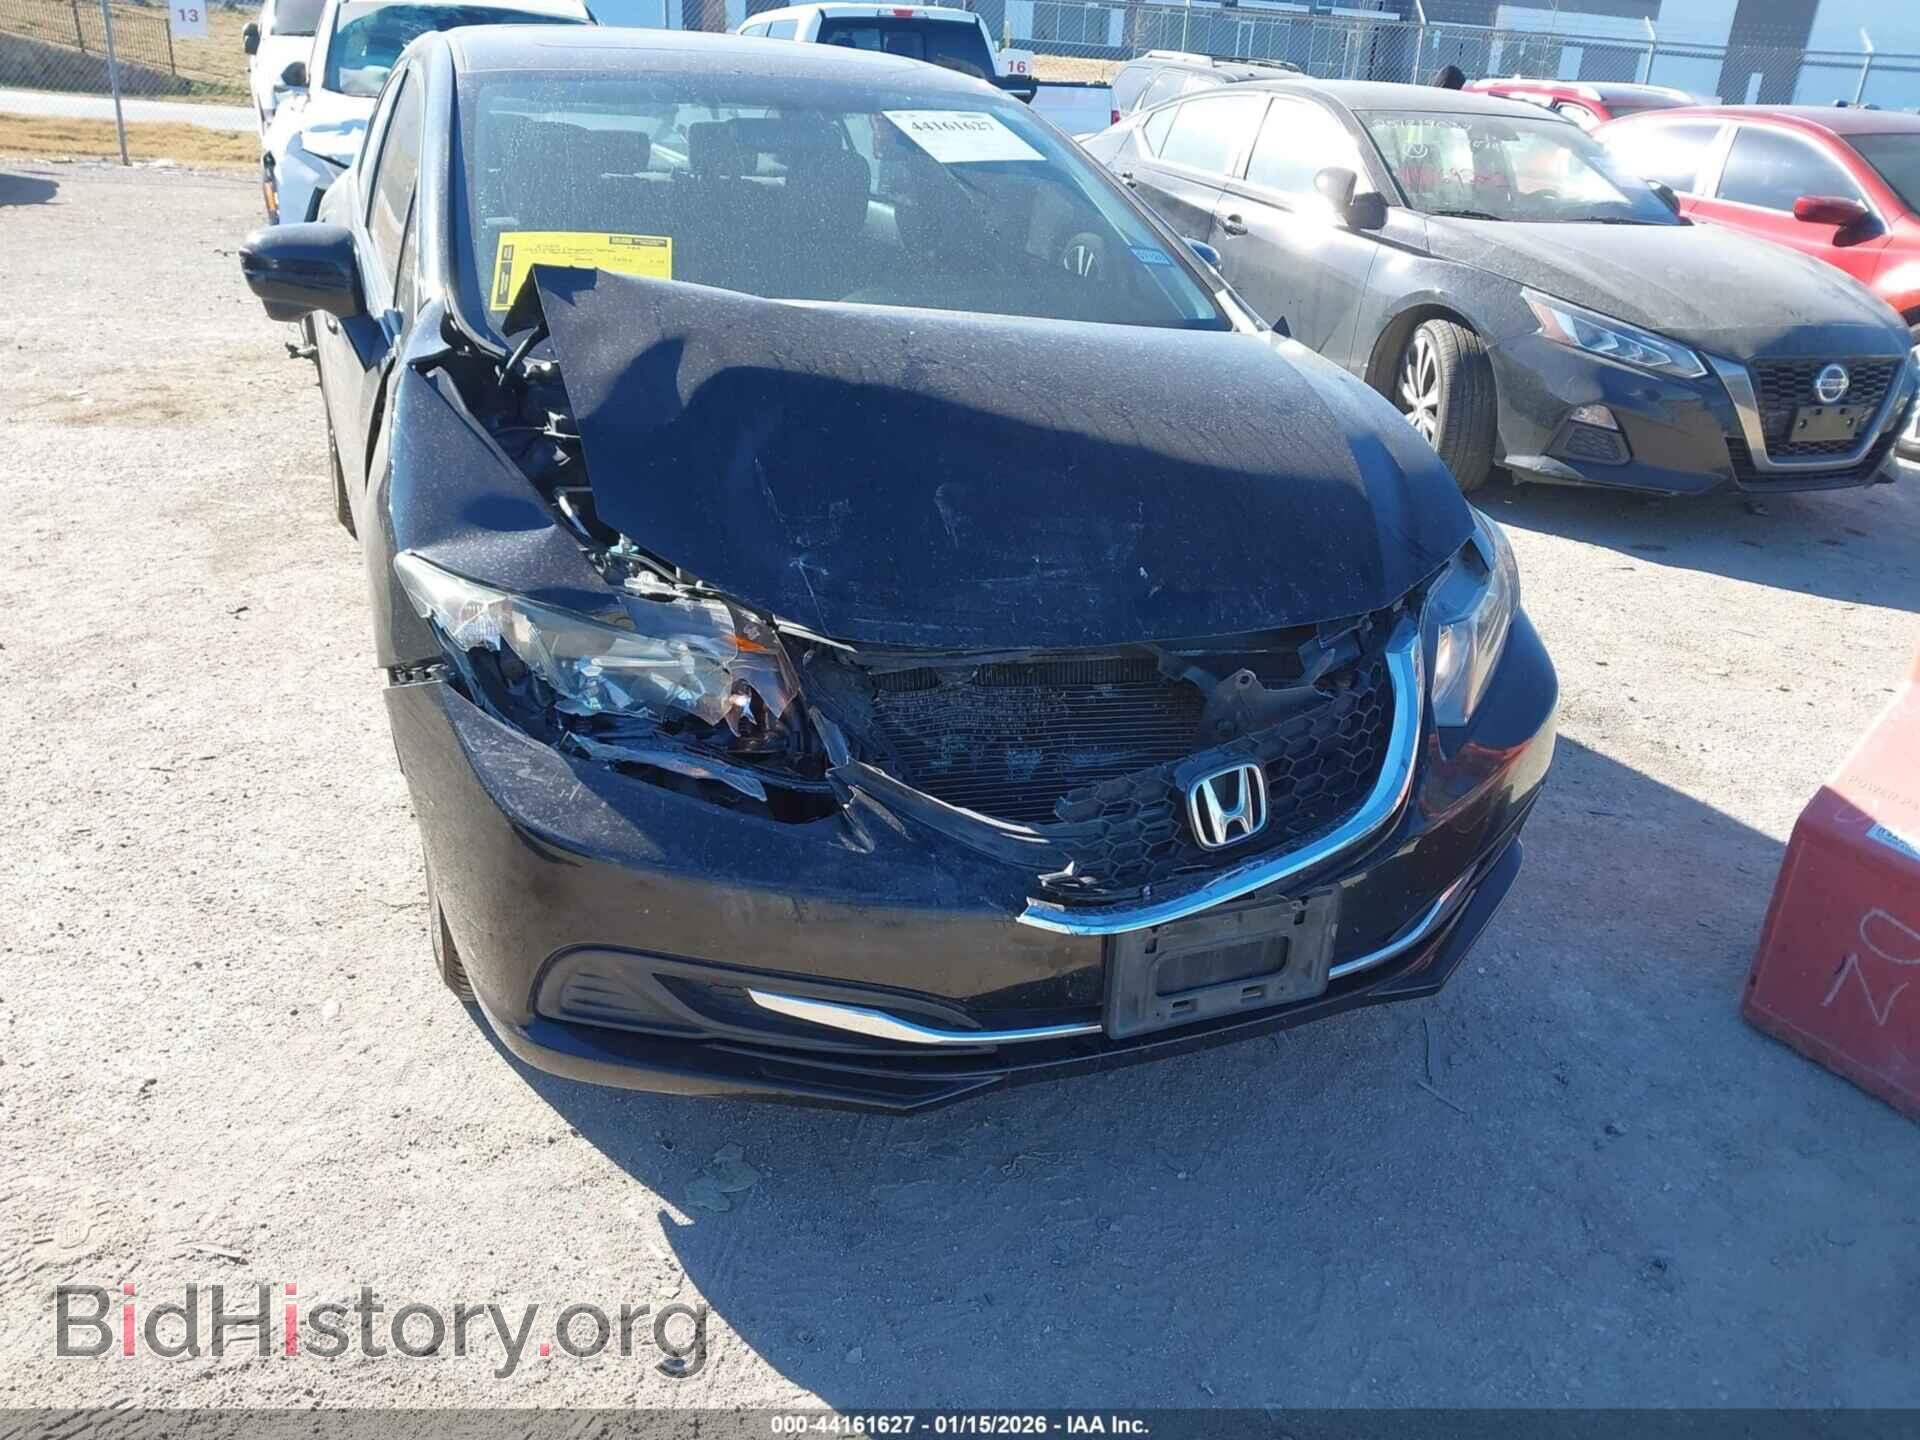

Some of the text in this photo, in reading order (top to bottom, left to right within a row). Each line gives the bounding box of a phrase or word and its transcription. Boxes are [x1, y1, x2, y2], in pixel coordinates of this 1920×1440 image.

[178, 8, 199, 23] 13
[1007, 59, 1027, 73] 16
[911, 119, 996, 133] 44161627
